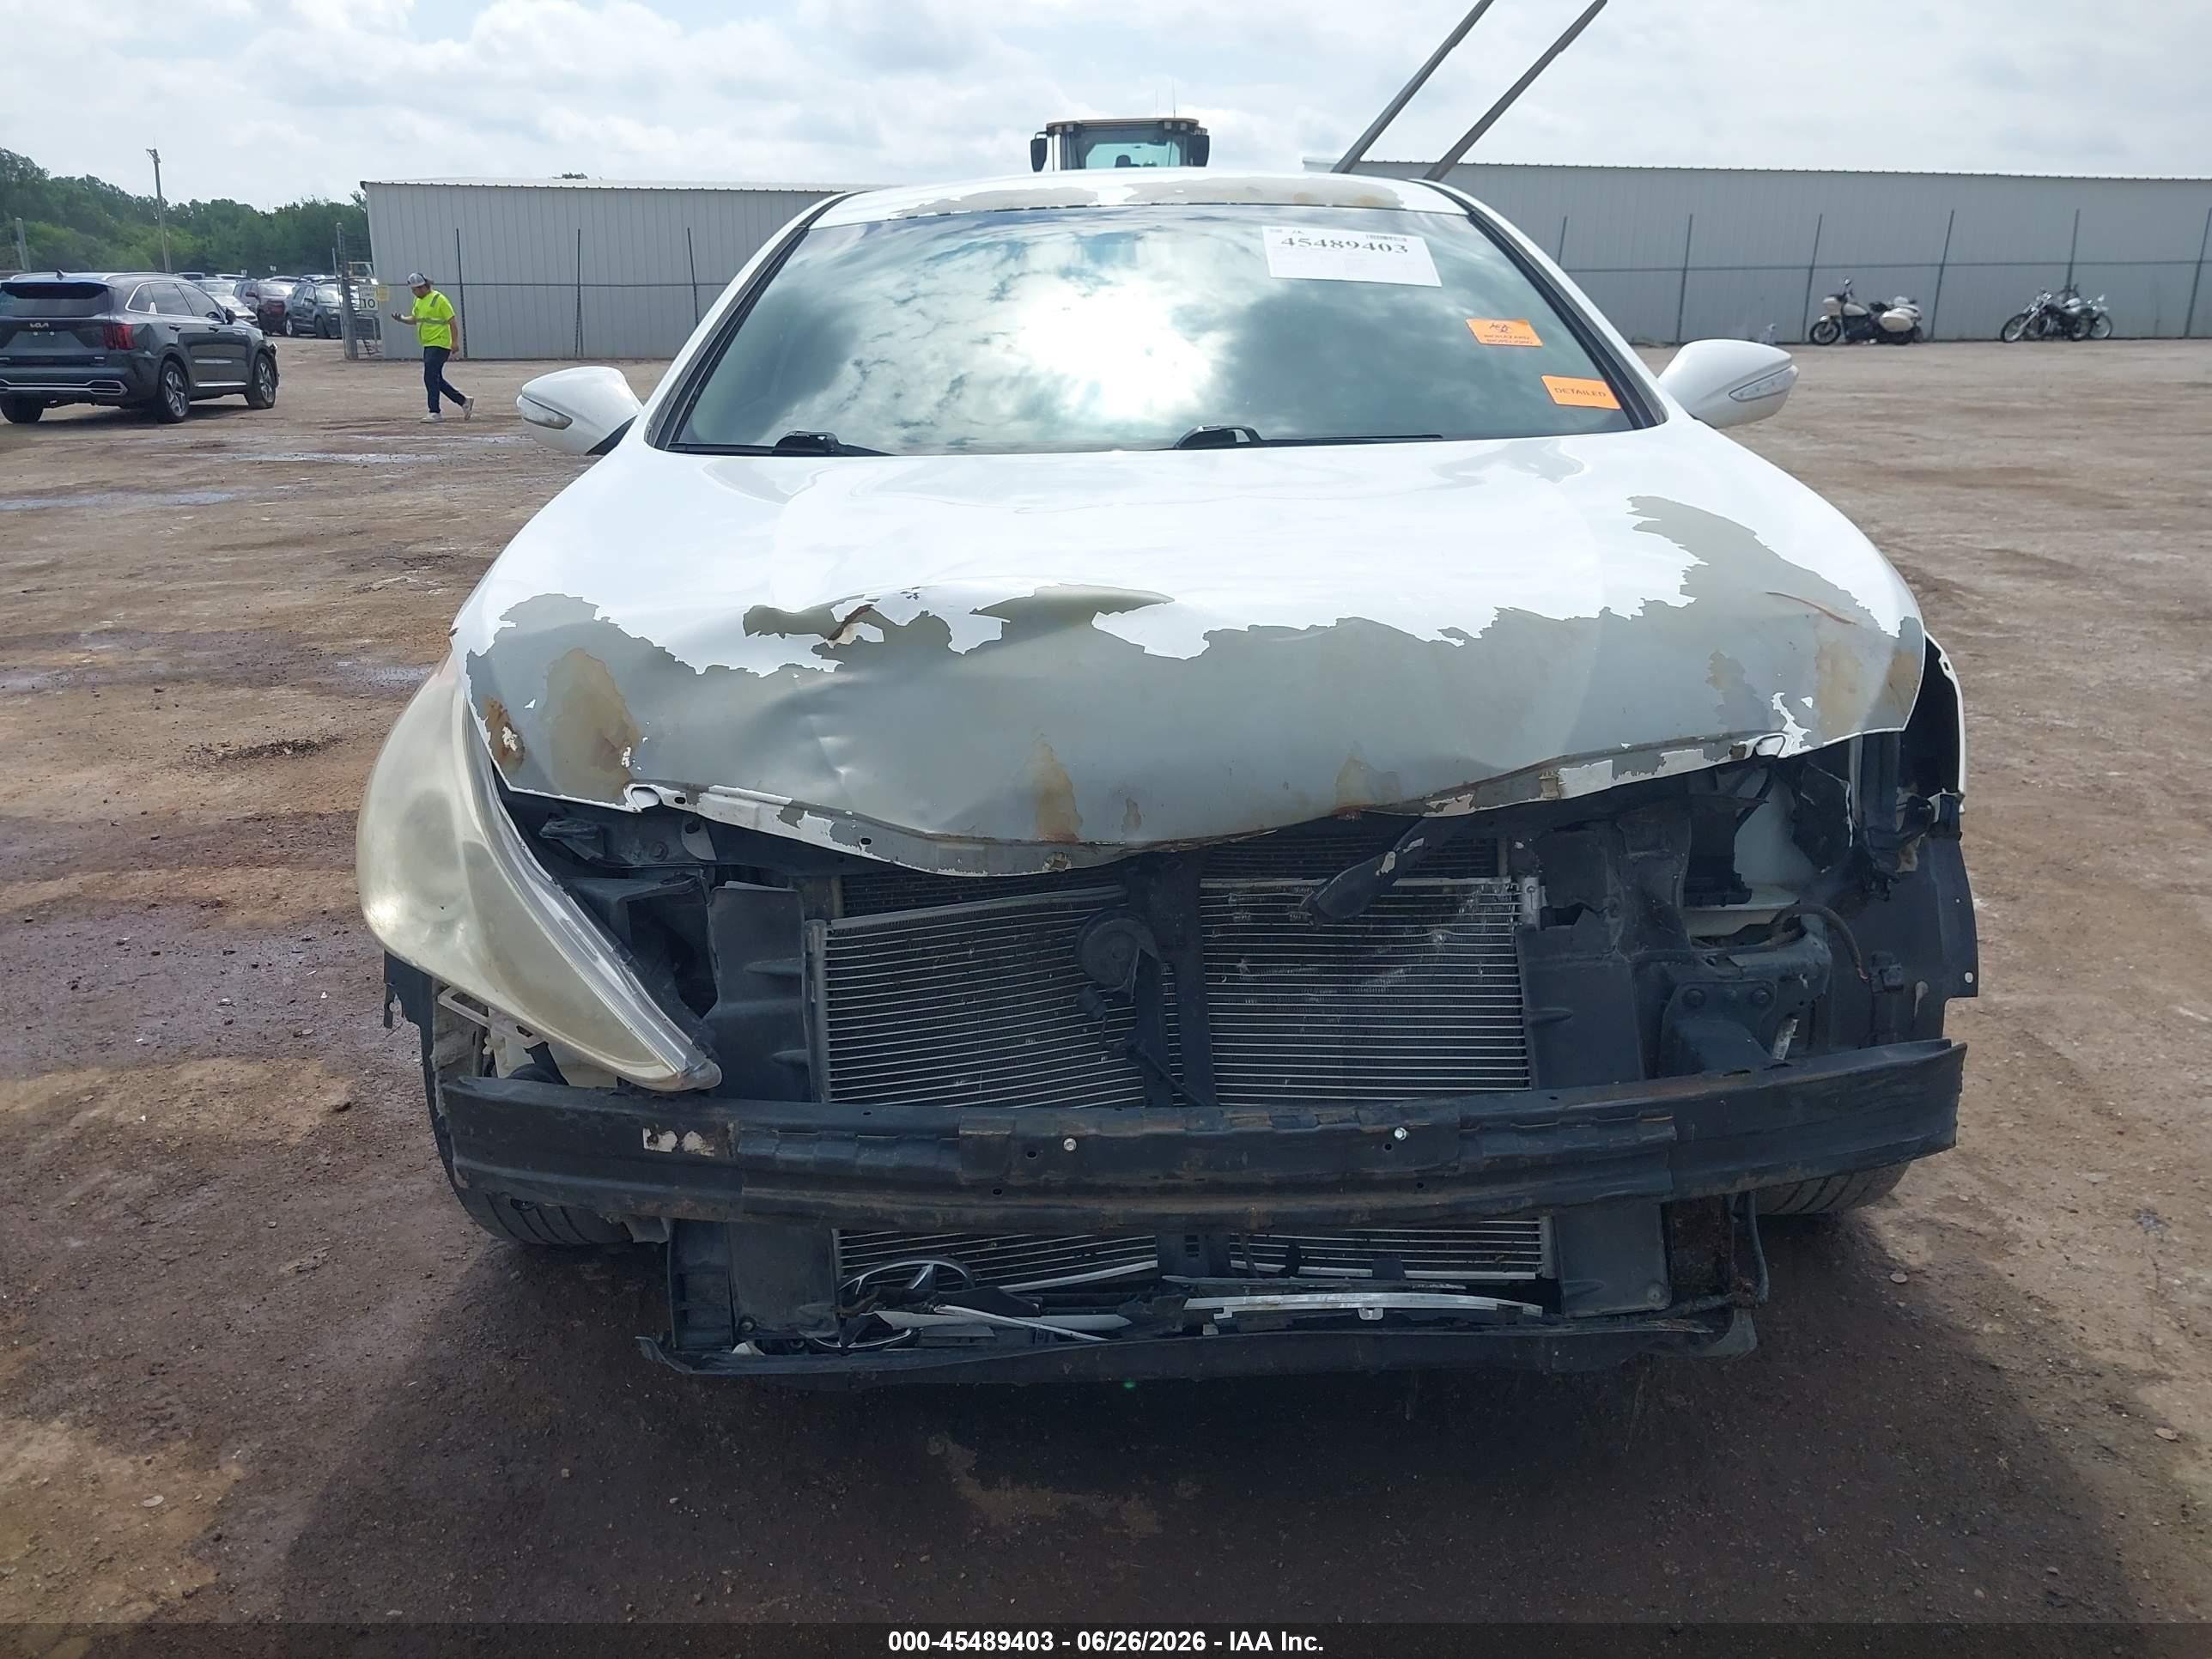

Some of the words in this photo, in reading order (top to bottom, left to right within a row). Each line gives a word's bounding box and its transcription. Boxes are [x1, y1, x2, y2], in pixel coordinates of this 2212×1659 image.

[1280, 237, 1409, 254] 45489403
[362, 298, 375, 308] 10
[1553, 387, 1607, 398] DETAILED
